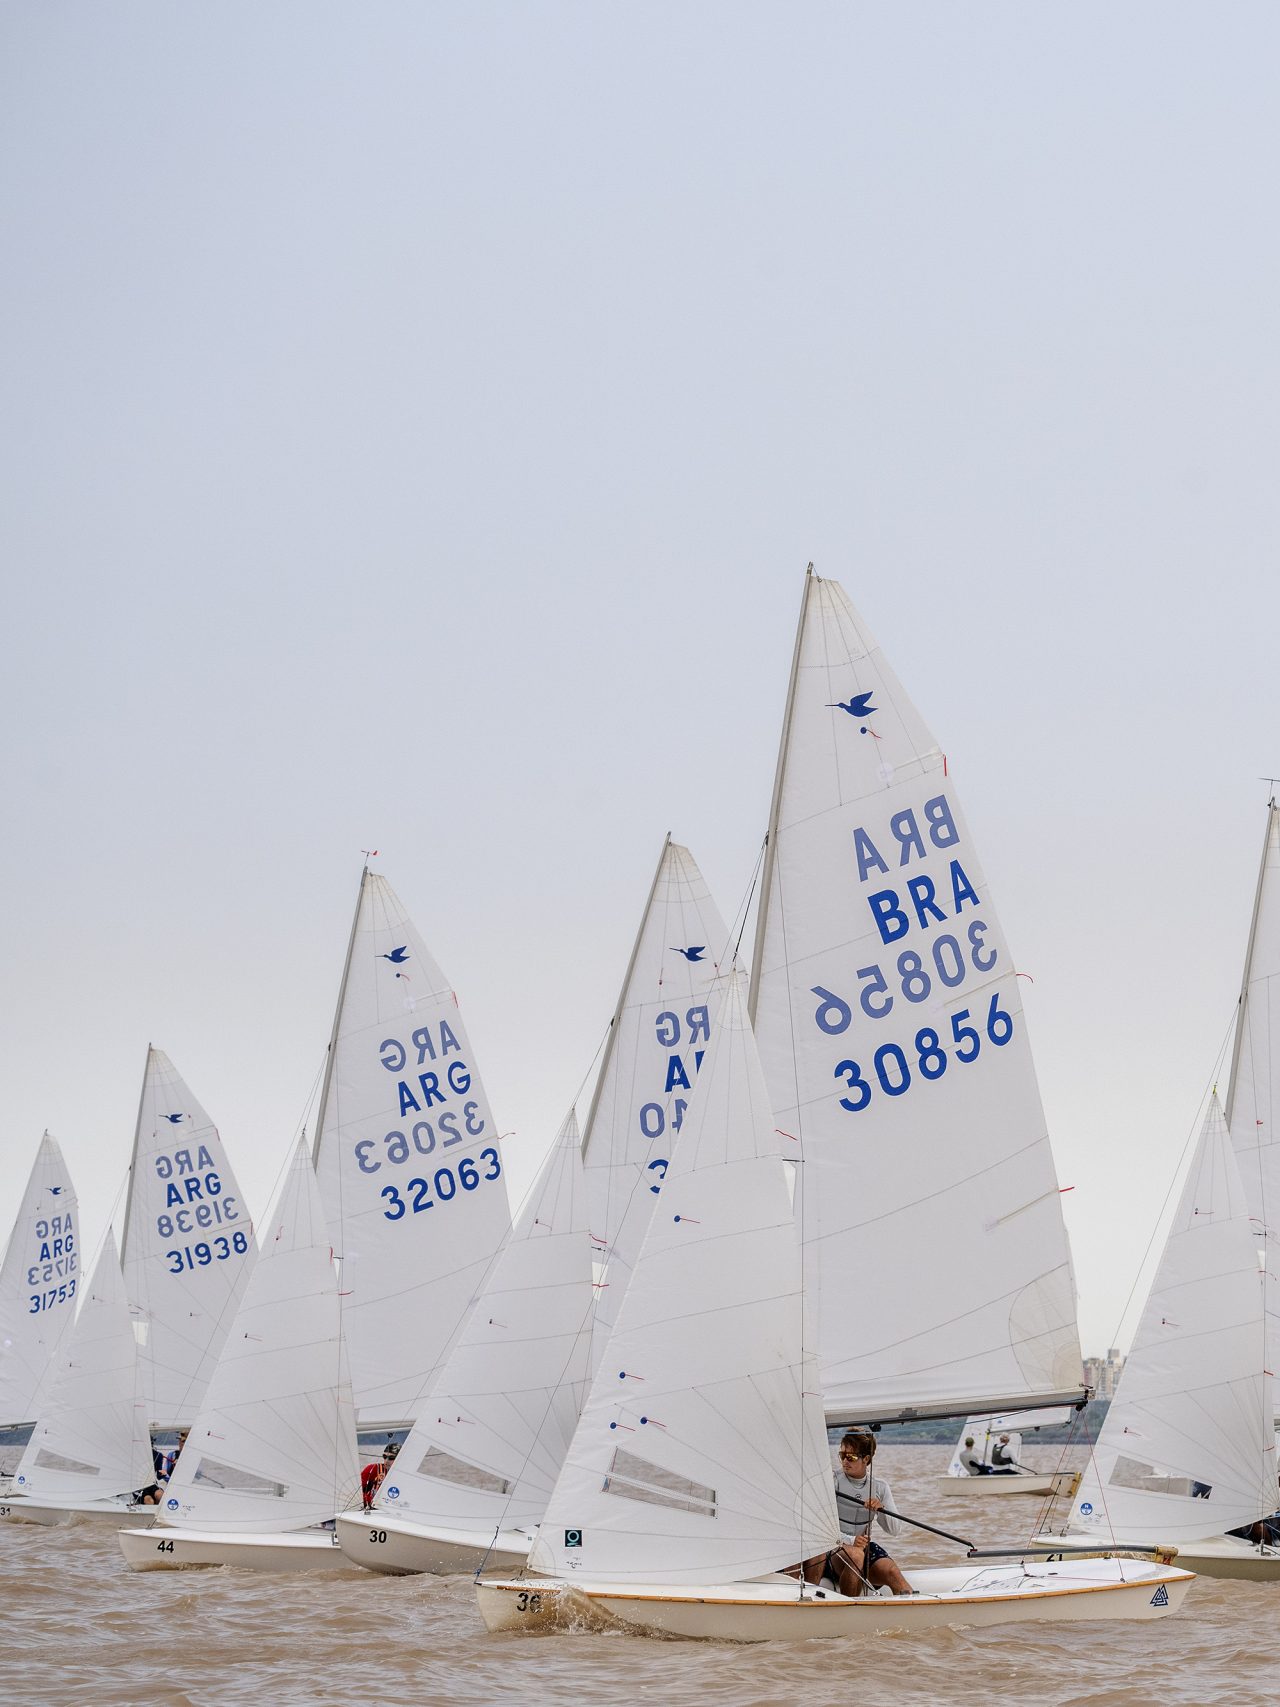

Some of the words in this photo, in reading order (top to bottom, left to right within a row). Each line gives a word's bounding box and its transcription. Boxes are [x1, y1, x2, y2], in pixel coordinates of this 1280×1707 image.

[867, 859, 981, 945] BRA
[834, 992, 1014, 1112] 30856
[398, 1061, 472, 1117] ARG
[166, 1172, 222, 1208] ARG
[381, 1148, 501, 1221] 32063
[39, 1234, 74, 1262] ARG
[166, 1231, 248, 1274] 31938
[29, 1279, 76, 1314] 31753
[157, 1540, 175, 1553] 44
[369, 1530, 387, 1543] 30
